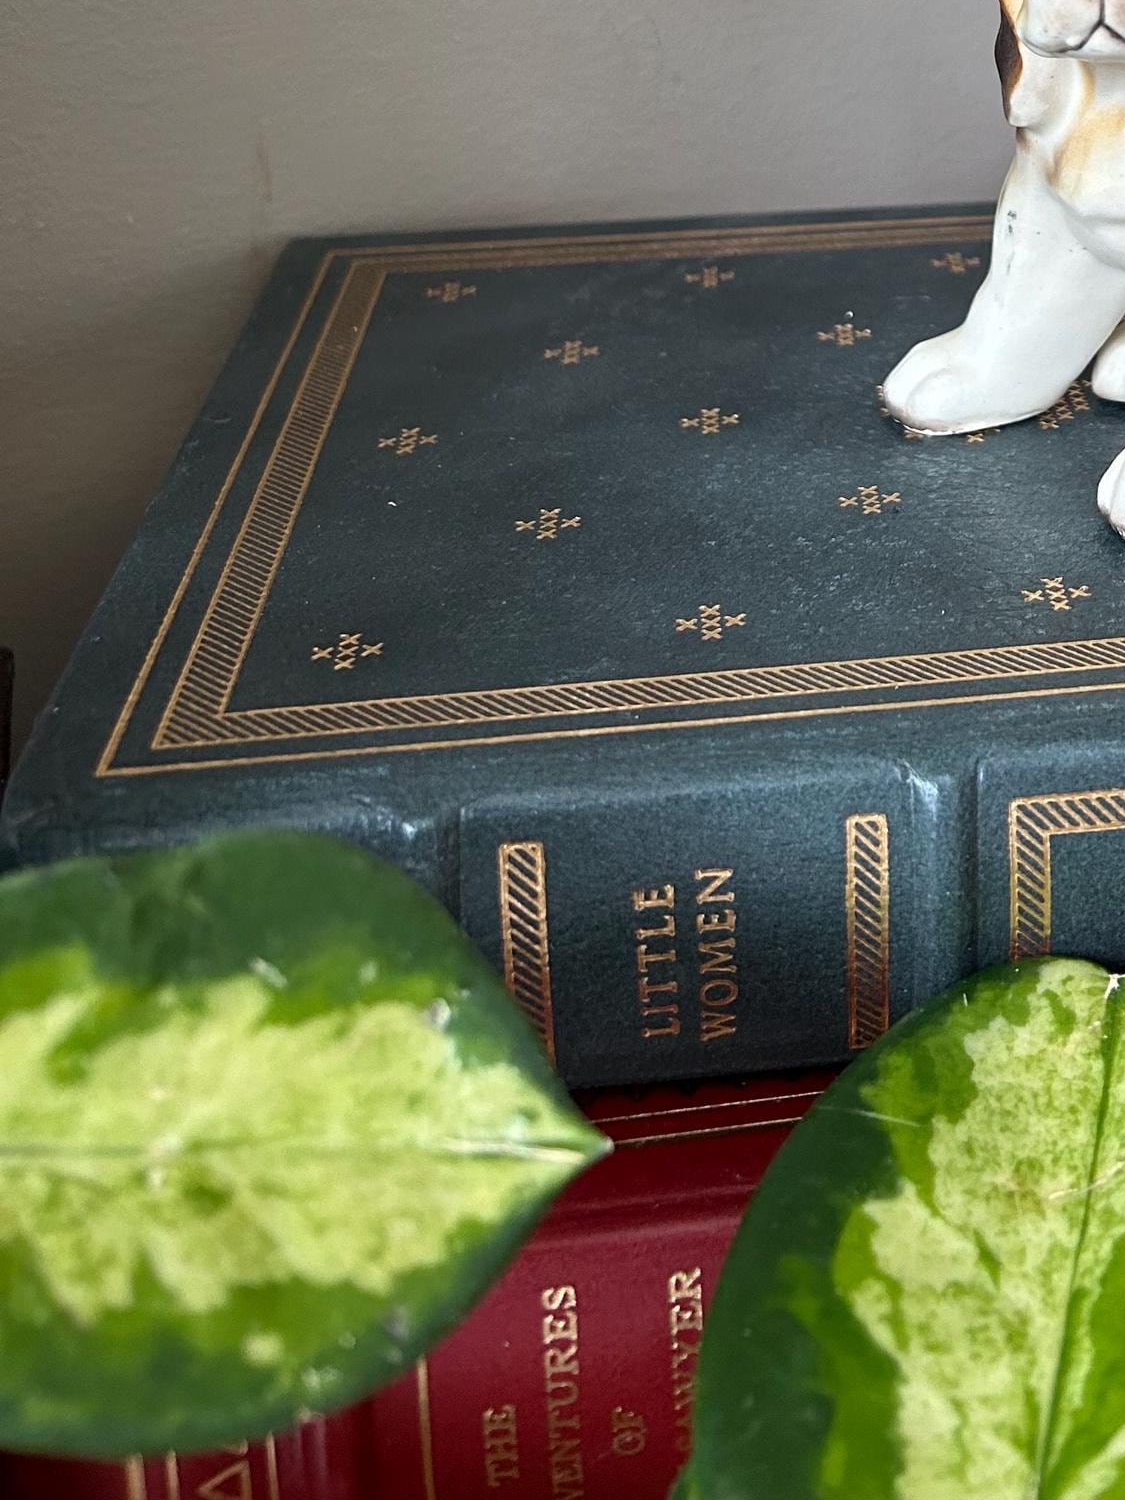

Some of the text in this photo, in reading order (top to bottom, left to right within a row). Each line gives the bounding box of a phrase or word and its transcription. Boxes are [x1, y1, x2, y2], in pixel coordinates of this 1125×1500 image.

[633, 883, 680, 1038] LITTLE
[694, 867, 739, 1041] WOMEN
[483, 1404, 520, 1487] THE
[611, 1406, 647, 1456] OF
